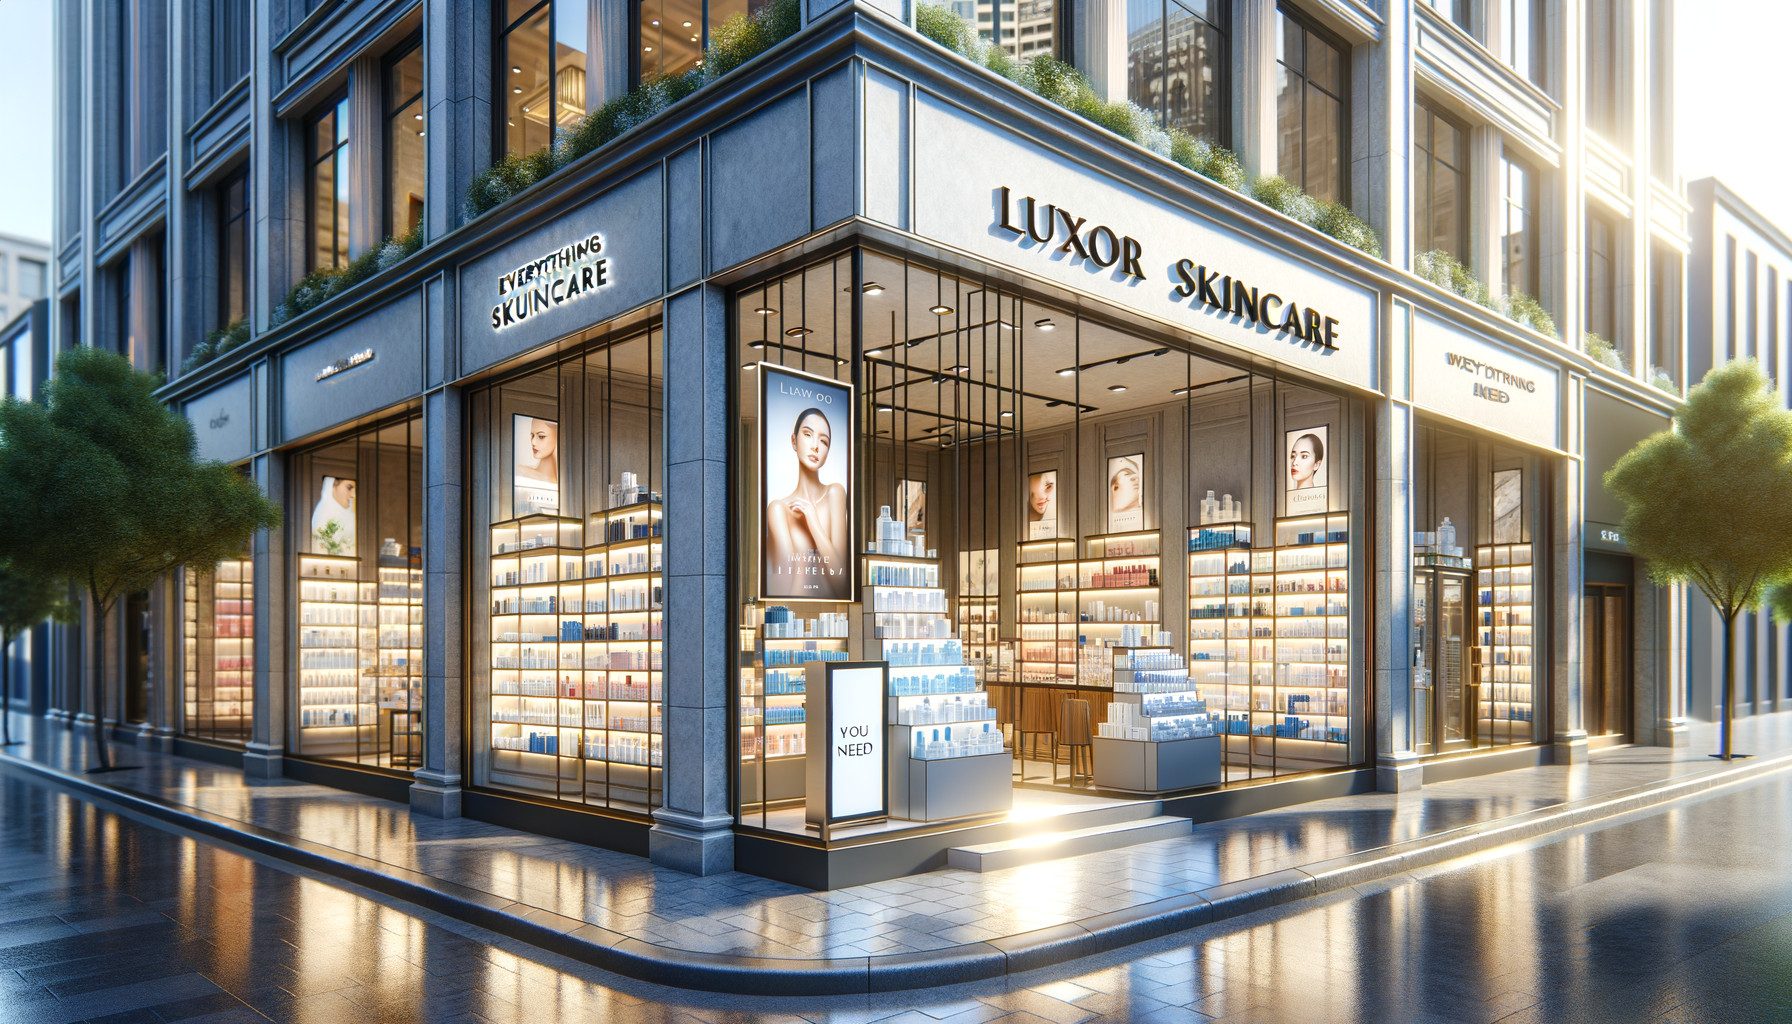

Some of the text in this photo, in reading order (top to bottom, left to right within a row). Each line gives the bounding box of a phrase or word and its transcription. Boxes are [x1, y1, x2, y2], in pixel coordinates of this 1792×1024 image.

[993, 186, 1340, 351] LUXOR SKINCARE
[840, 725, 869, 739] YOU
[837, 742, 873, 757] NEED
